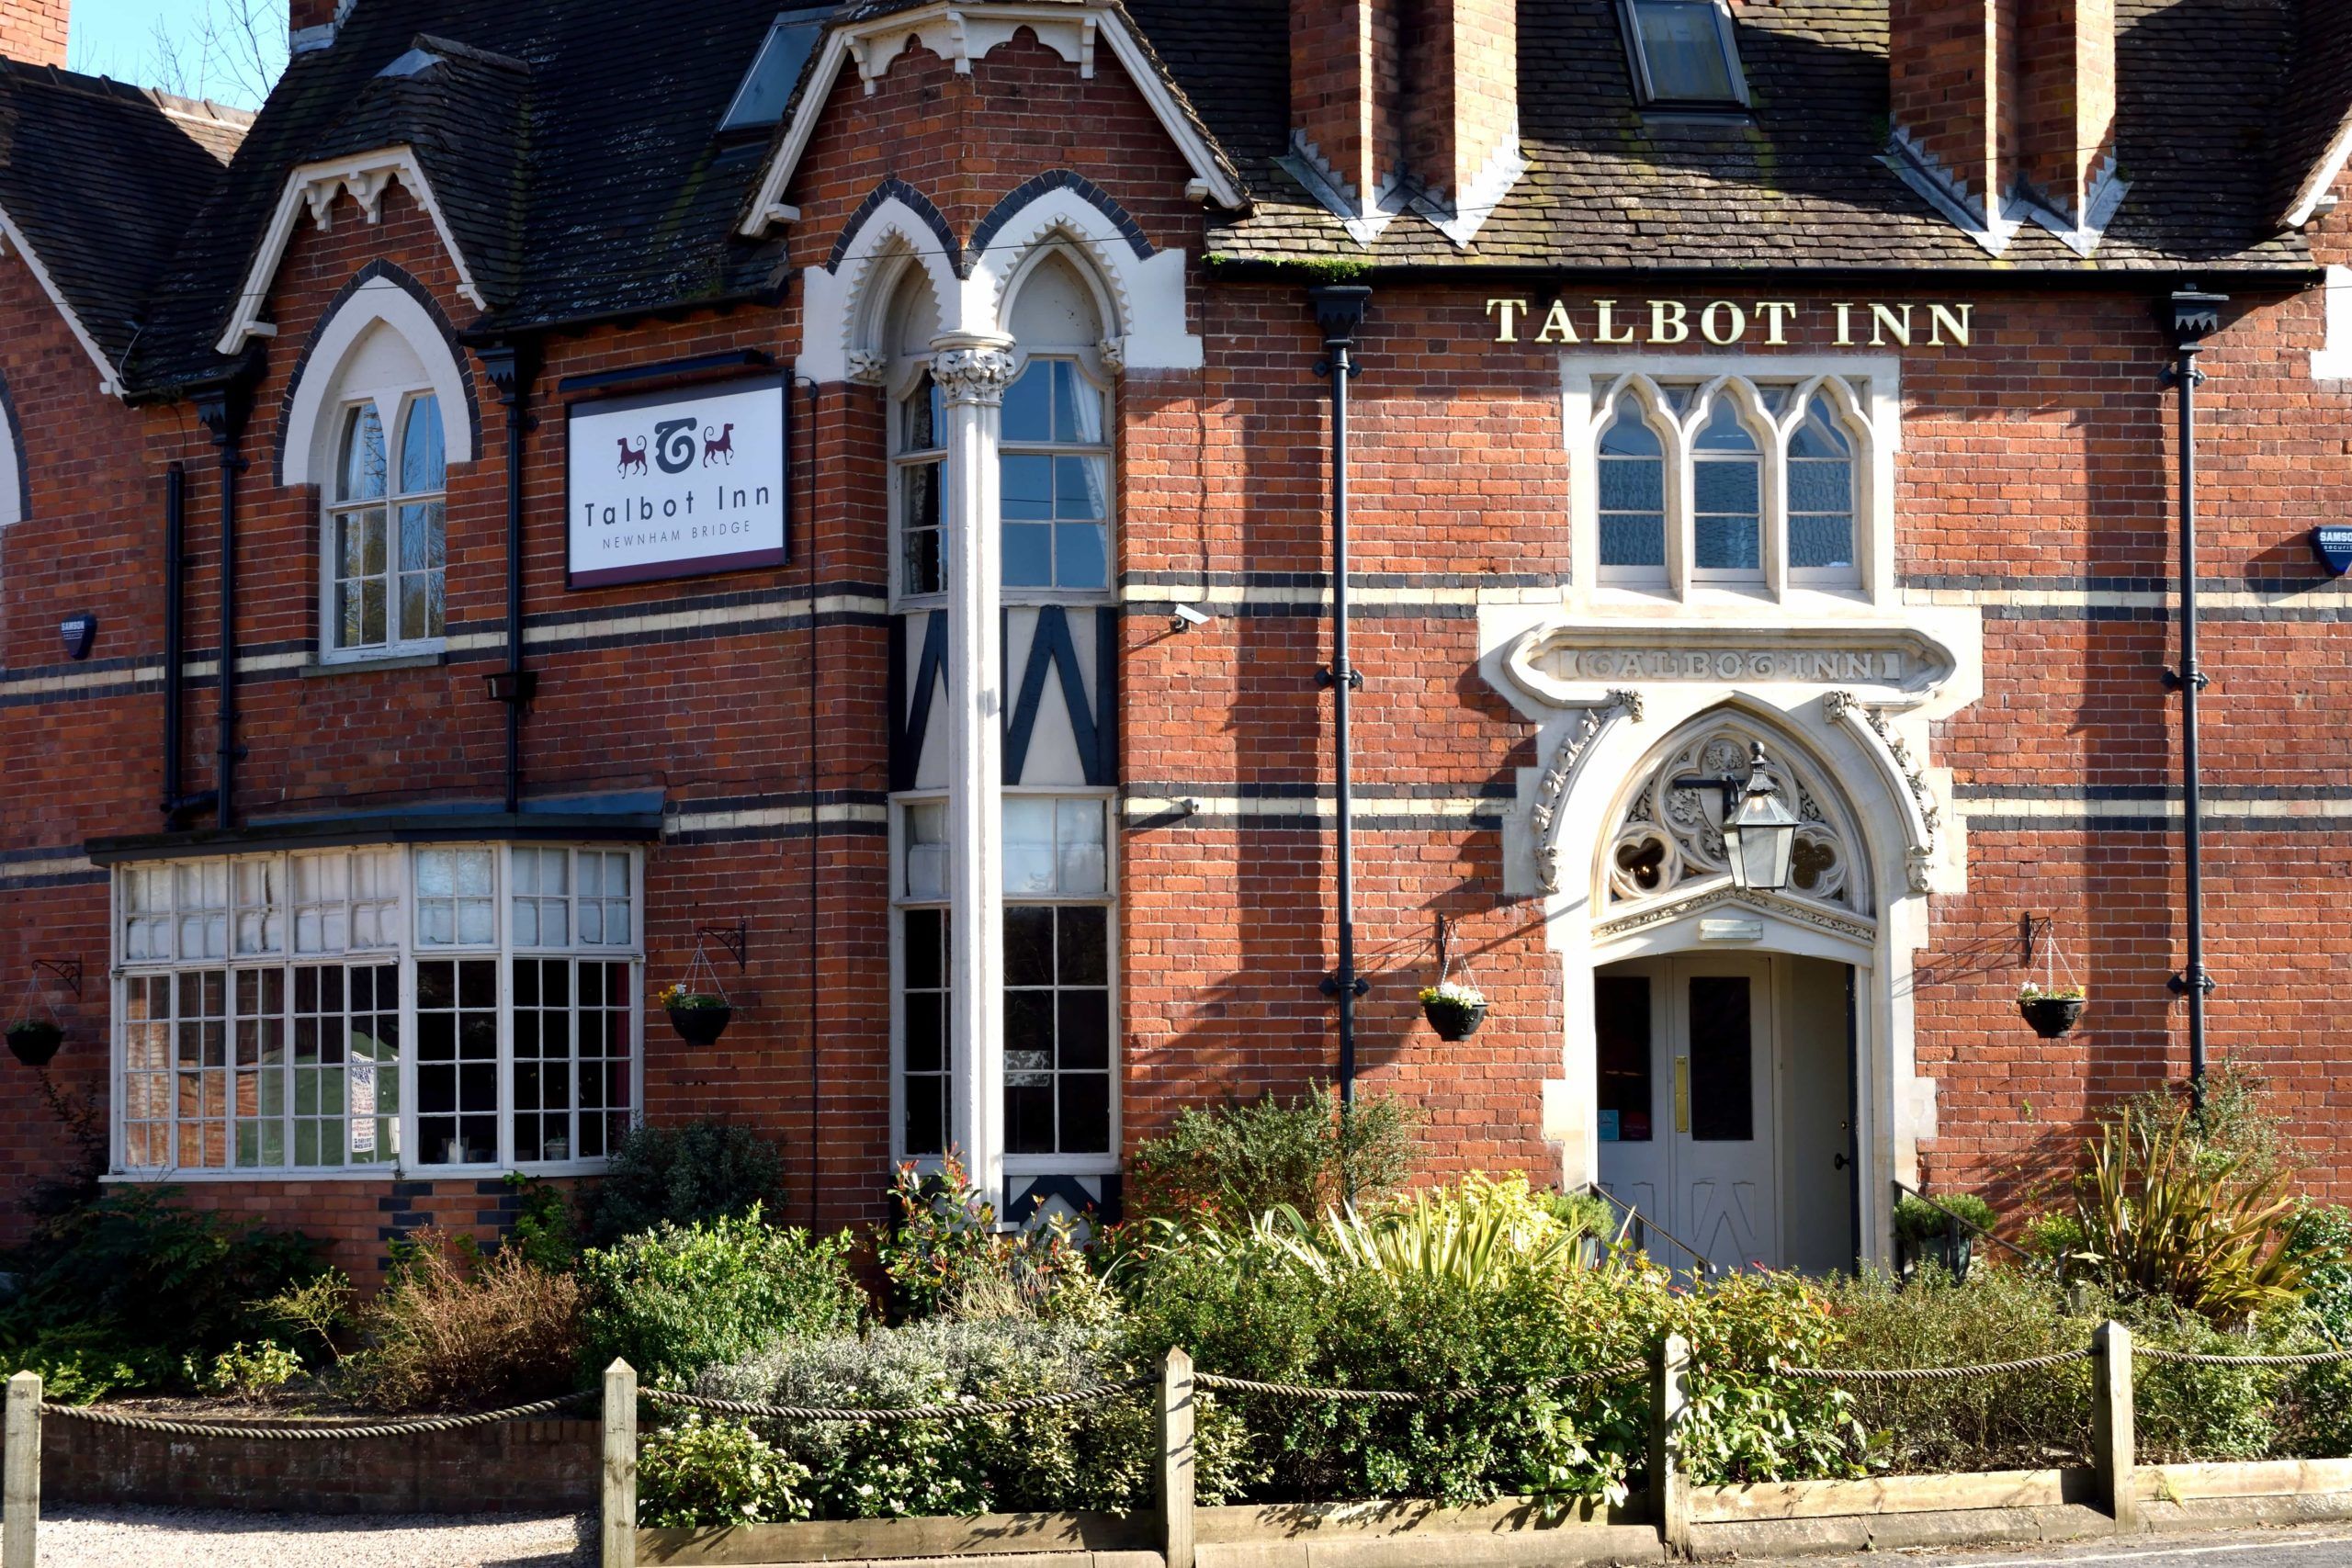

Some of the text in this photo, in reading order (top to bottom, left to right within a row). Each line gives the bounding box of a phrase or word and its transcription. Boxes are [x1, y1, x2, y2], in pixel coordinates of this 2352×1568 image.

[1486, 299, 1974, 348] TALBOT INN
[584, 485, 770, 527] Talbot Inn
[602, 520, 752, 549] NEWNHAM BRIDGE
[1587, 650, 1874, 681] TALBOT INN
